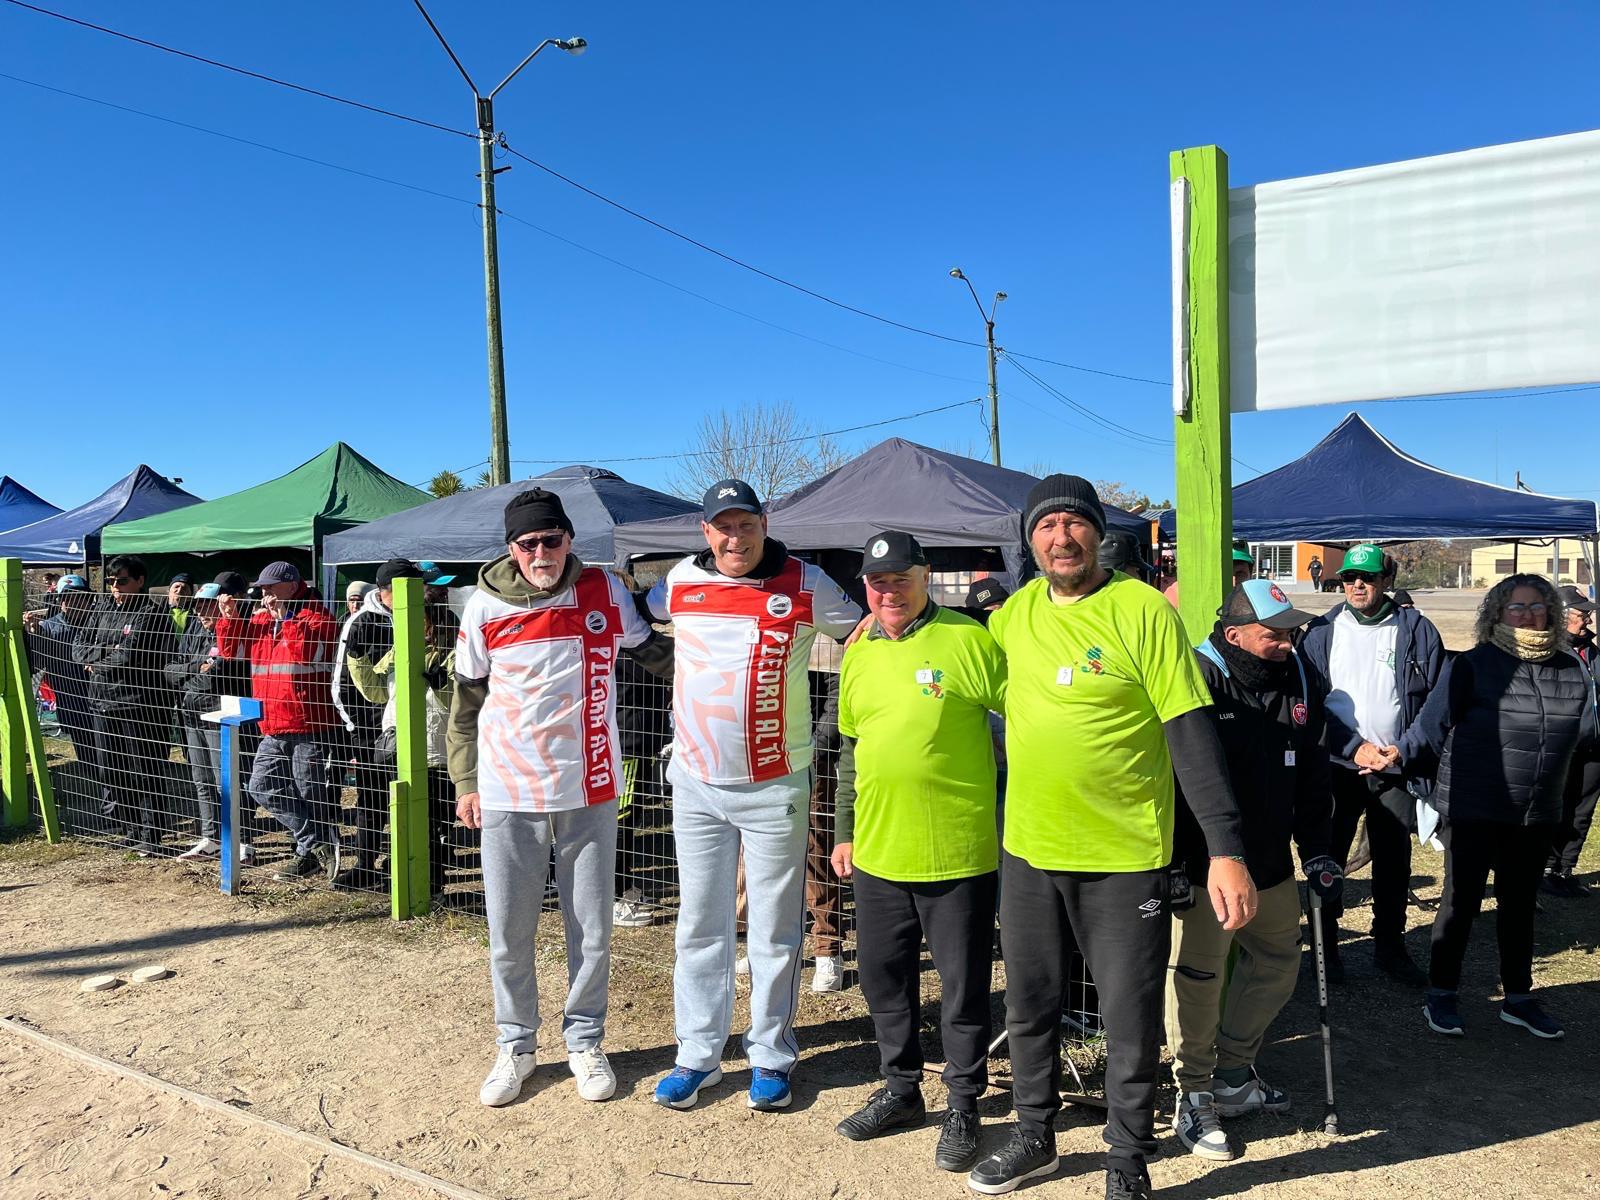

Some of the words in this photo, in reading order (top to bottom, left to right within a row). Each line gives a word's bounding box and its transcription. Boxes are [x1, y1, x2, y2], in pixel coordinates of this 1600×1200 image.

[755, 630, 789, 713] PIEDRA
[1219, 712, 1235, 720] LUIS
[589, 735, 611, 789] ALTA
[755, 719, 782, 767] ALTA
[1142, 909, 1161, 919] umbro
